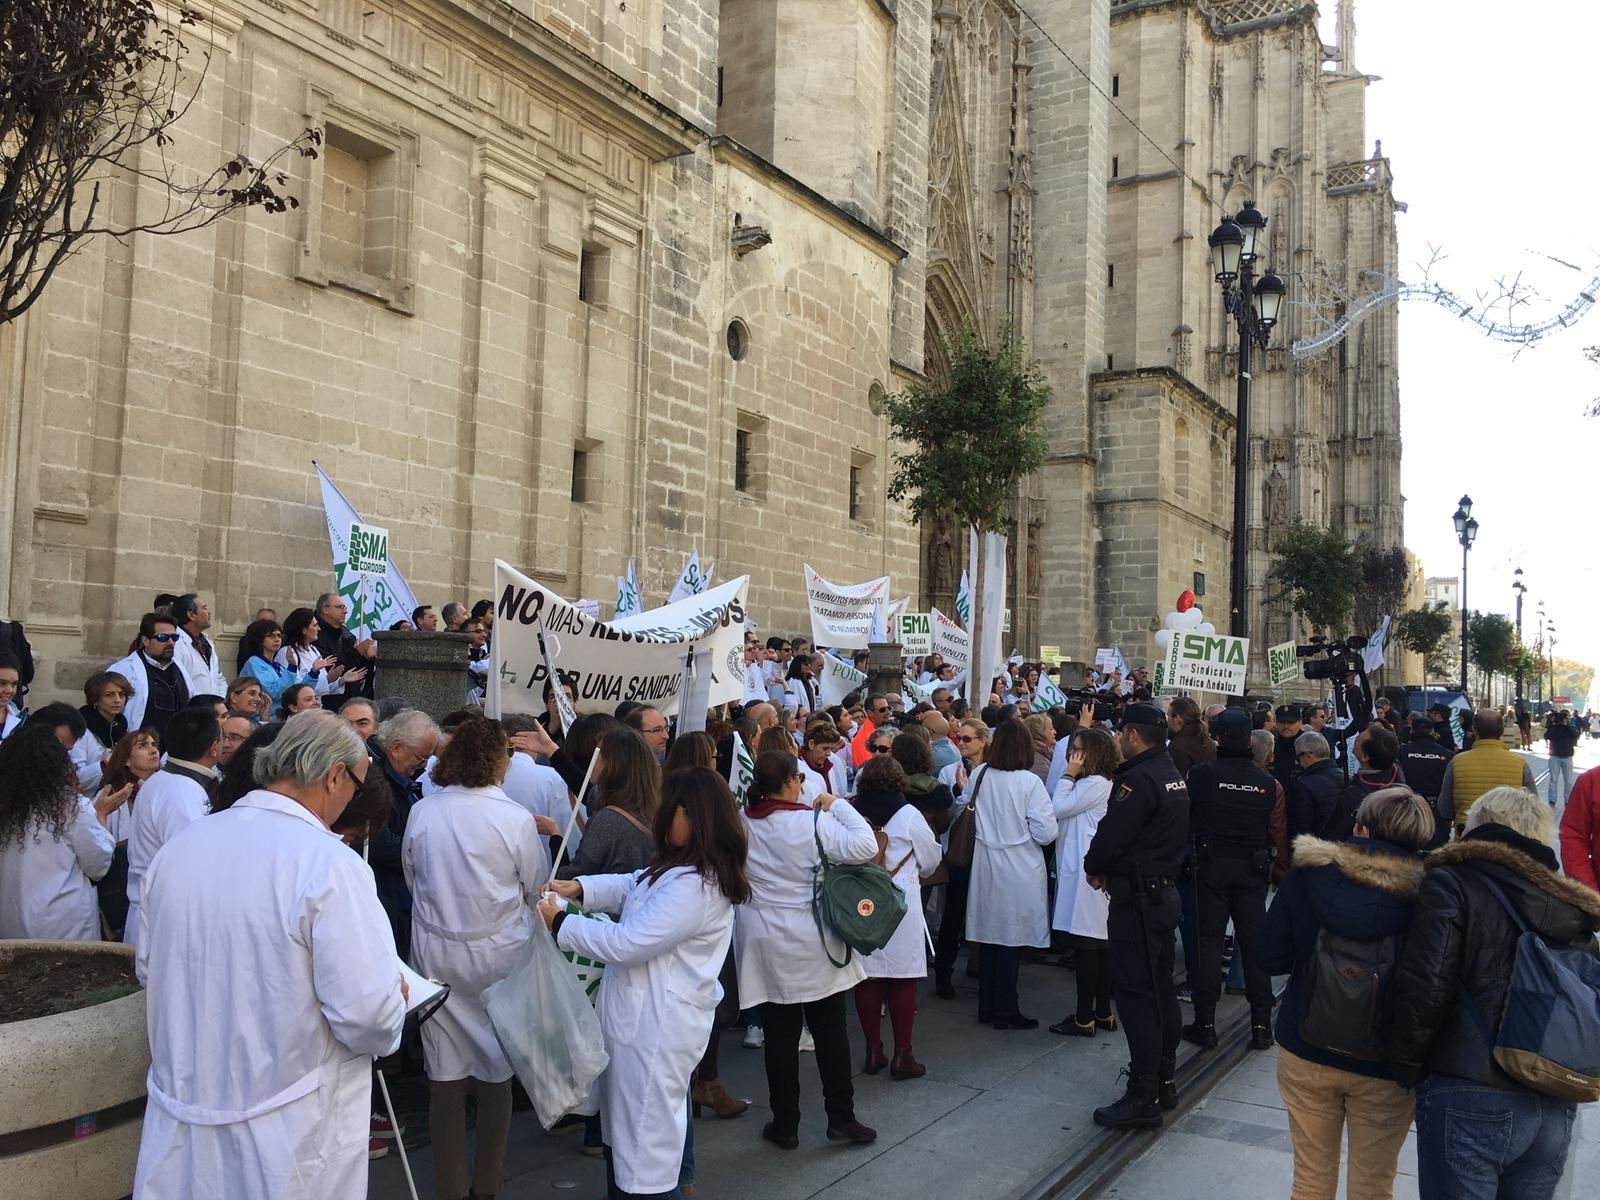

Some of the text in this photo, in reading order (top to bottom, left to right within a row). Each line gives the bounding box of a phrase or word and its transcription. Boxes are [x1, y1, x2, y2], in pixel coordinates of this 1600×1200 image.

[361, 531, 387, 562] SMA
[498, 584, 544, 625] NO
[815, 590, 849, 606] MINUTOS
[902, 615, 930, 634] SMA
[1183, 634, 1245, 666] SMA
[1278, 645, 1296, 671] SMA
[832, 663, 858, 682] POR
[1190, 663, 1233, 679] Sindicato
[582, 672, 621, 701] UNA
[624, 672, 682, 701] SANIDAD
[1180, 675, 1237, 693] Médico Andaluz
[1218, 782, 1260, 792] POLICIA
